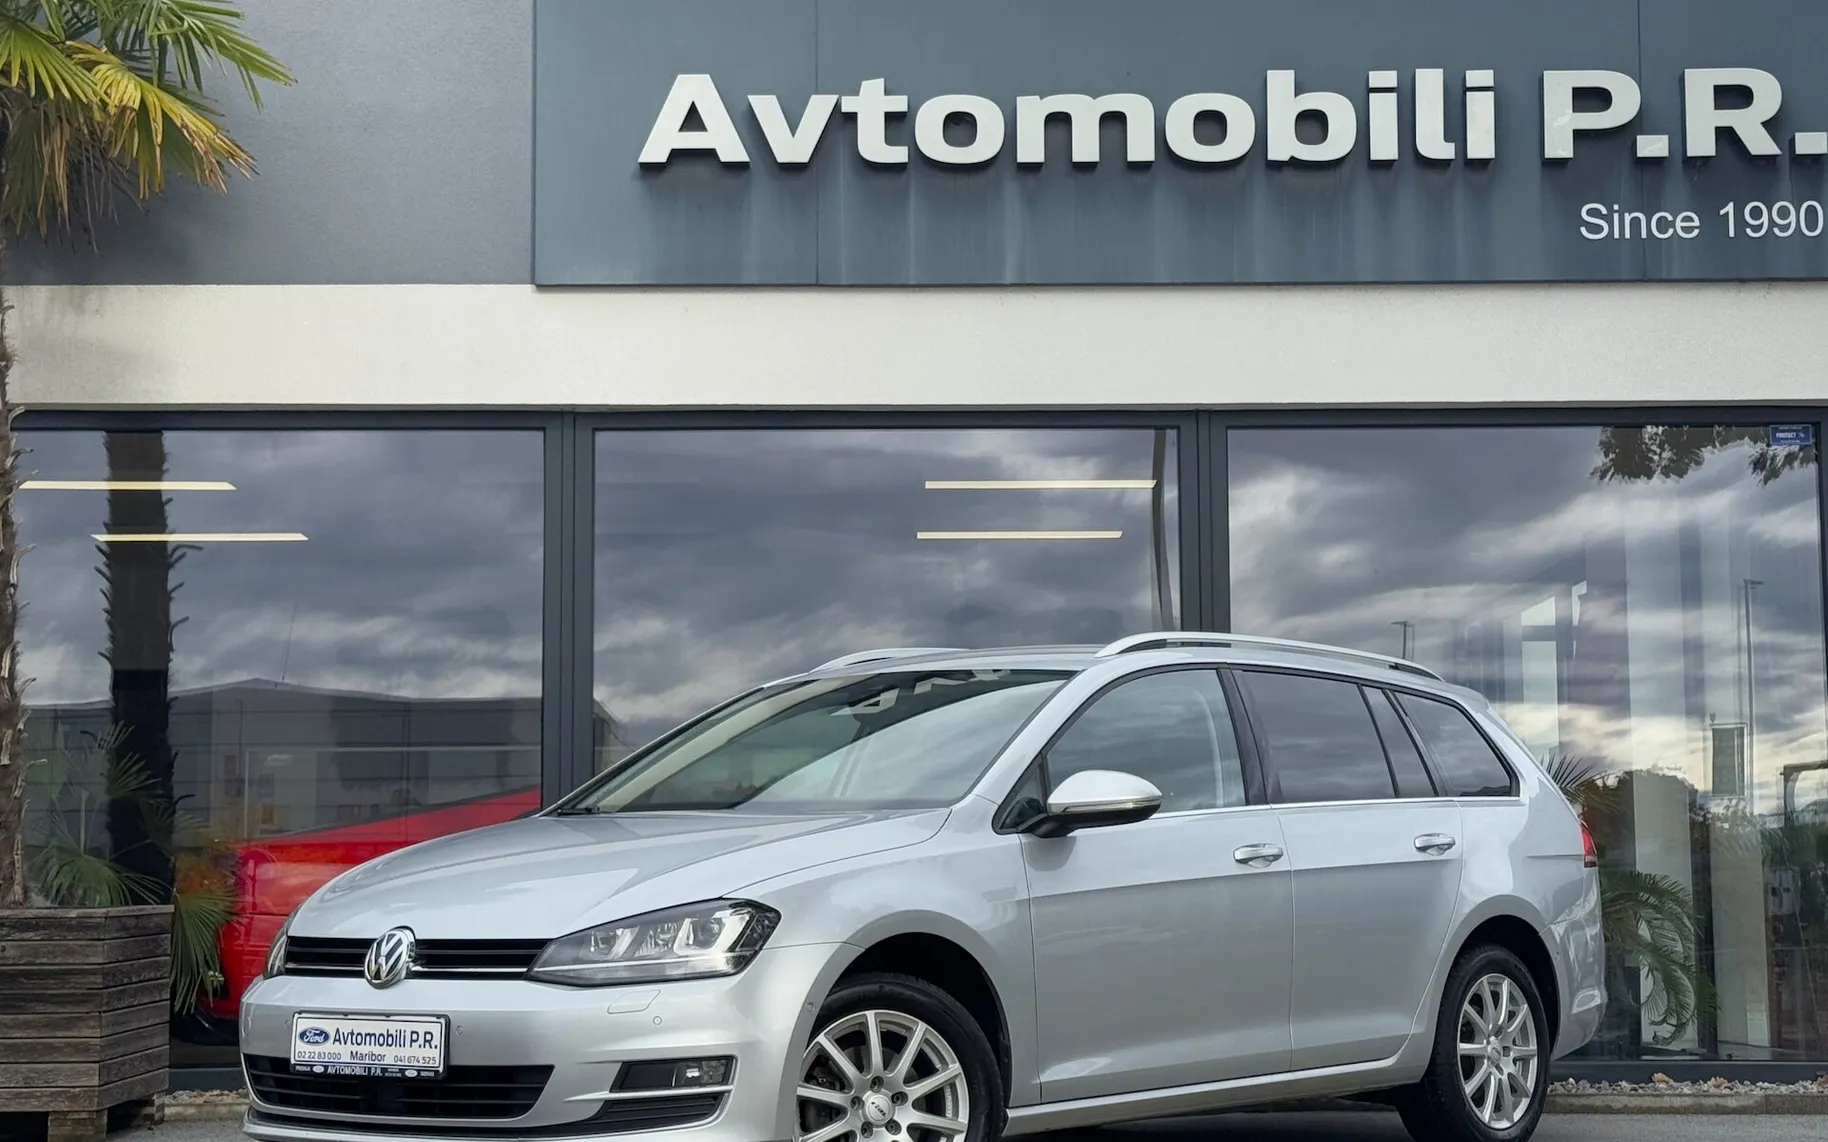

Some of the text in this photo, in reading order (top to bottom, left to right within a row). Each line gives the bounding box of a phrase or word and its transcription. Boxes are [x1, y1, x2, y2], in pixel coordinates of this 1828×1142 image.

[638, 67, 1828, 164] Avtomobili P.R.
[1579, 200, 1825, 240] Since 1990
[332, 1027, 438, 1049] Avtomobili P.R.
[349, 1050, 386, 1063] Maribor
[422, 1056, 437, 1065] 525
[326, 1066, 368, 1076] AVTOMOBILI
